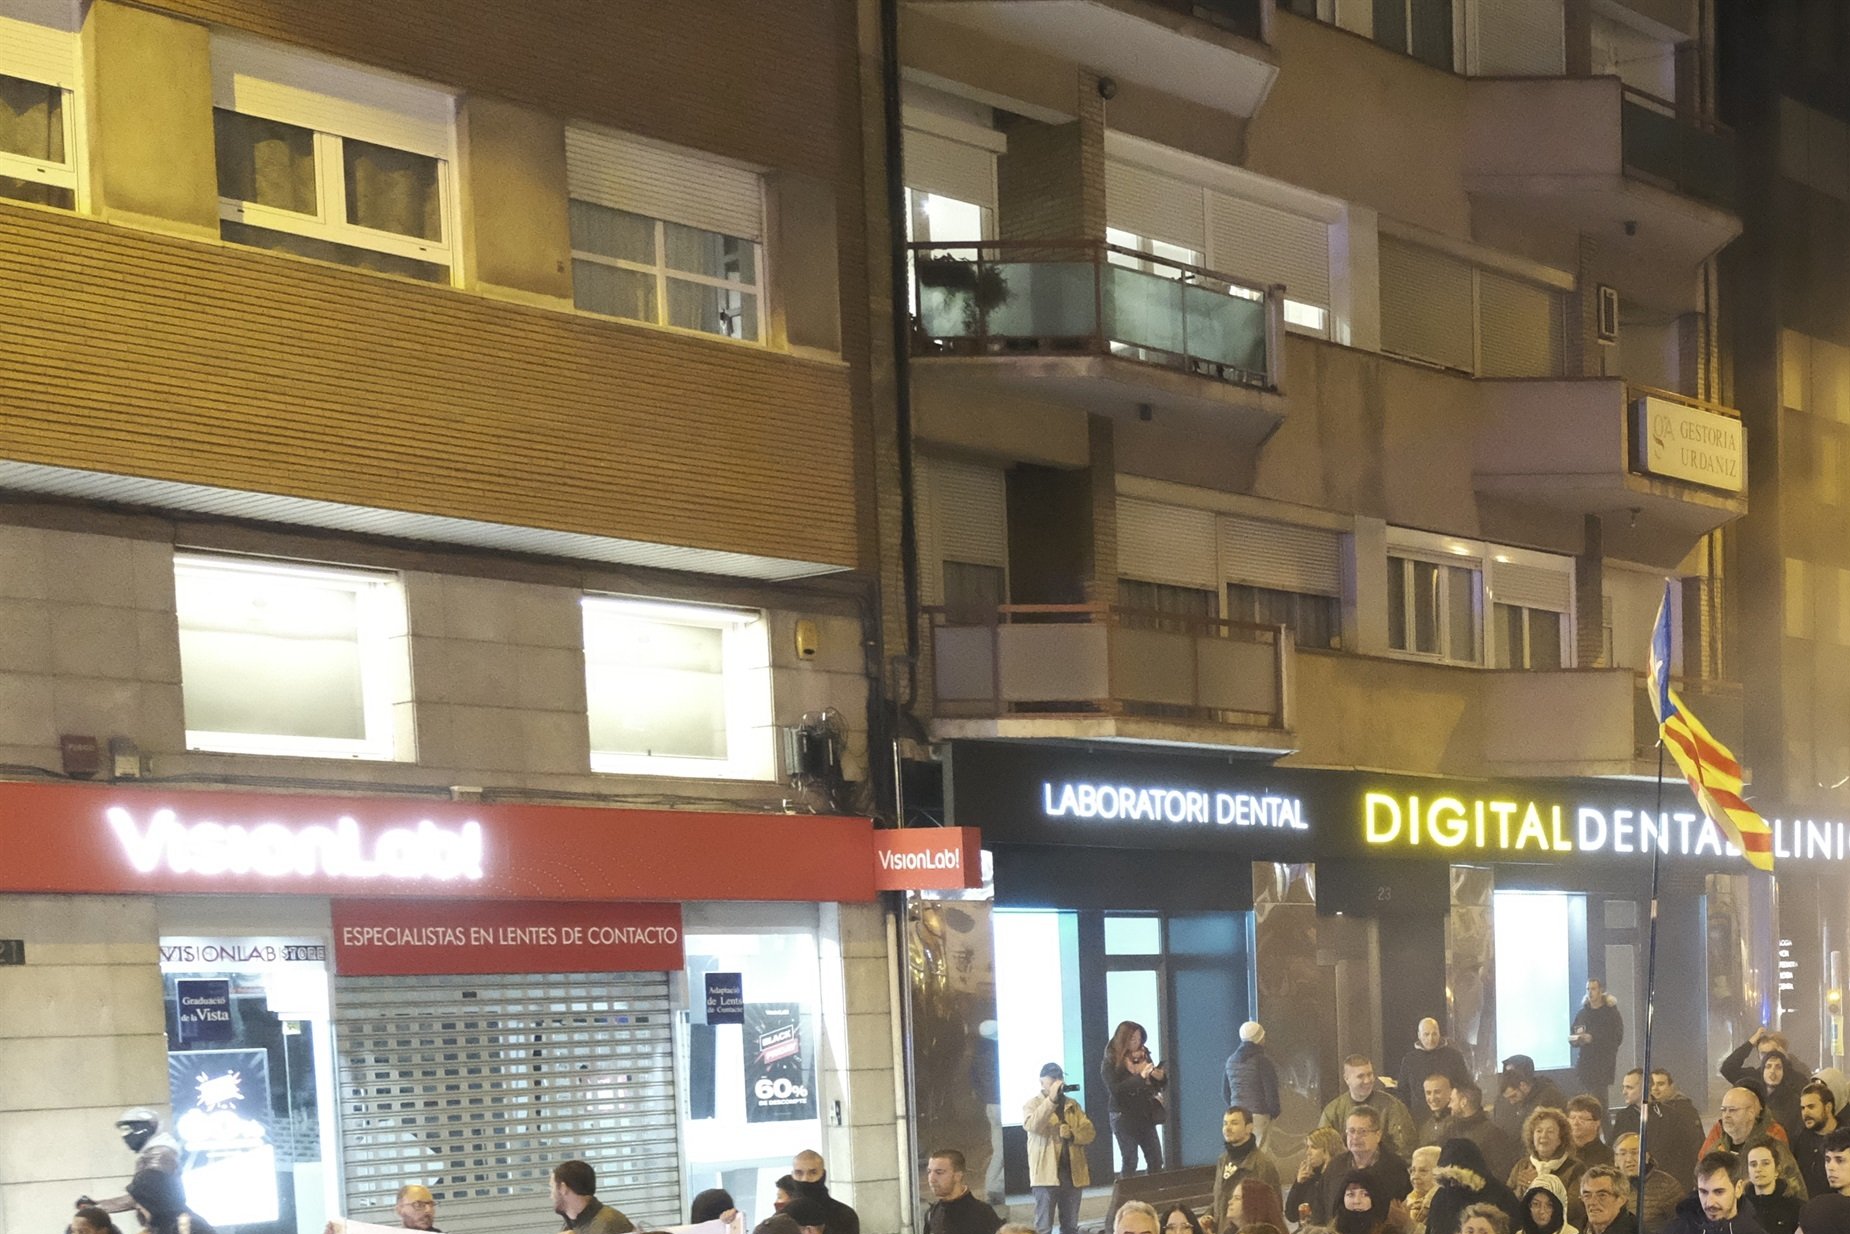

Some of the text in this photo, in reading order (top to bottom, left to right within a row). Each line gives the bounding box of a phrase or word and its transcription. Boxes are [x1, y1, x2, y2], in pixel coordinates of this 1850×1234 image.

[1680, 420, 1737, 451] GESTORIA
[1681, 448, 1737, 477] URDANIZ
[1044, 782, 1309, 829] LABORATORI DENTAL
[878, 848, 960, 870] VisionLab!
[343, 926, 678, 947] ESPECIALISTAS EN LENTES DE CONTACTO
[160, 945, 277, 962] VISIONLAB
[707, 997, 718, 1006] de
[181, 1014, 190, 1022] de
[196, 1008, 229, 1021] Vista
[762, 1029, 793, 1047] BLACK
[755, 1078, 808, 1099] 60%
